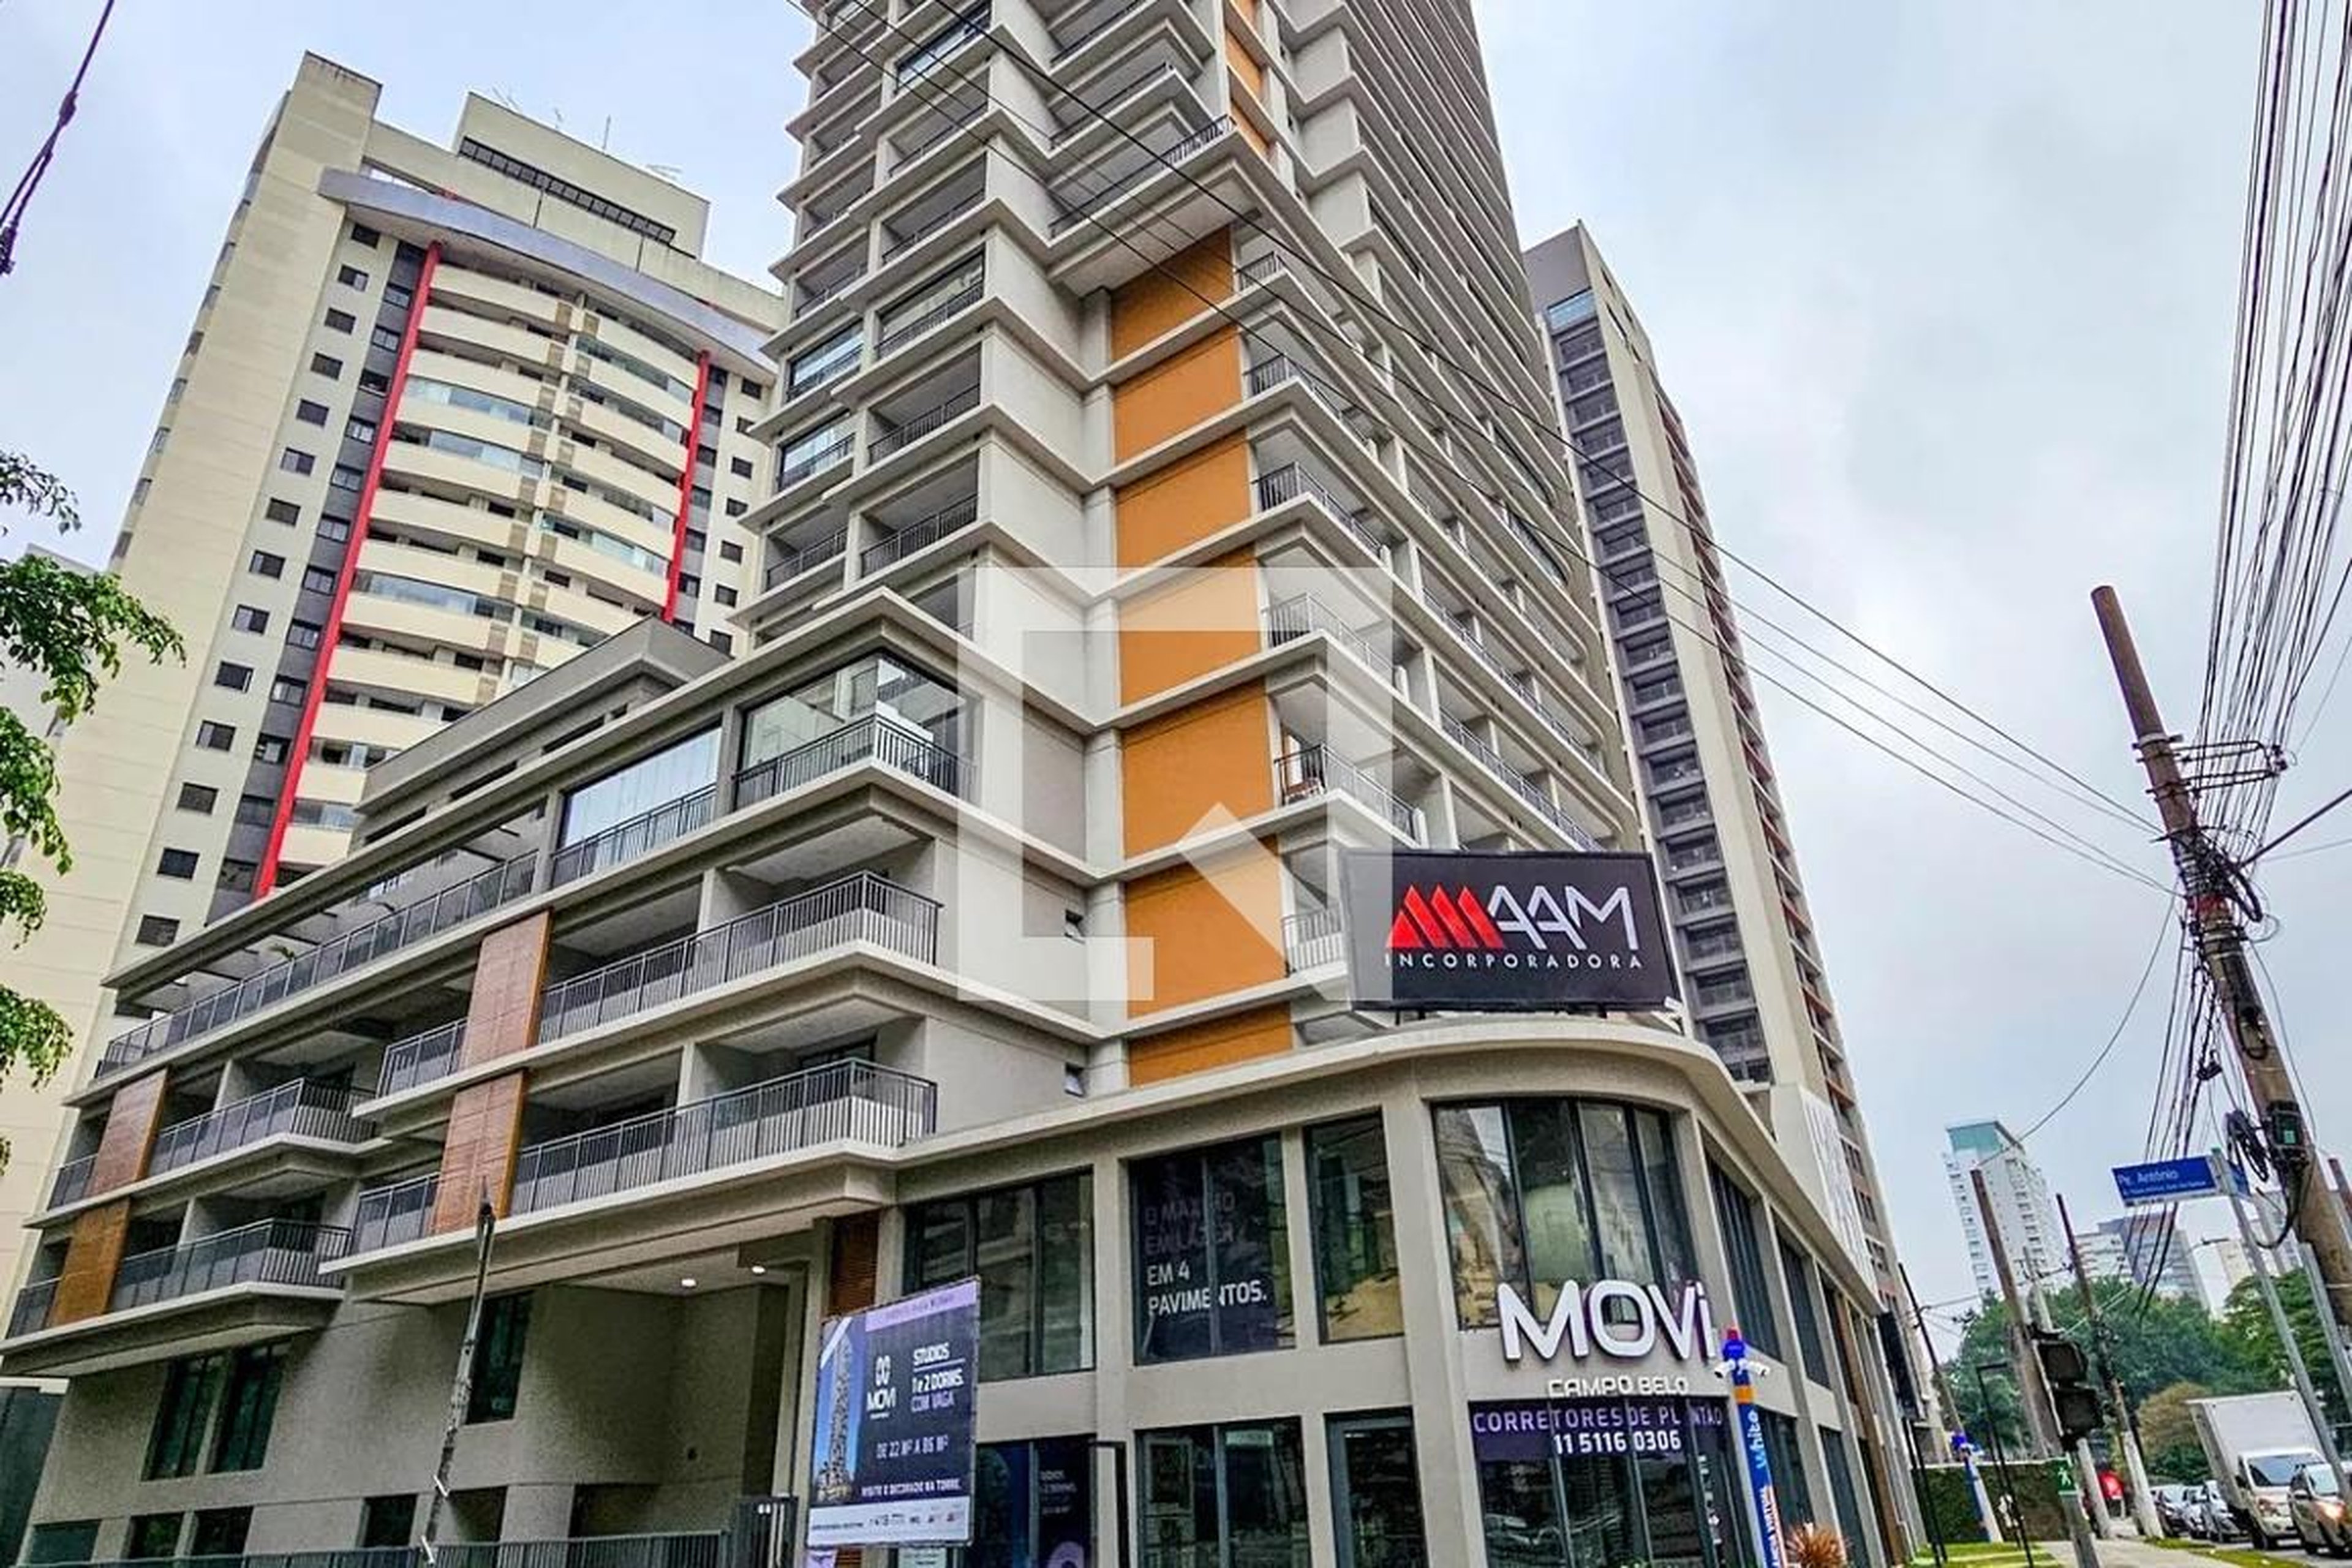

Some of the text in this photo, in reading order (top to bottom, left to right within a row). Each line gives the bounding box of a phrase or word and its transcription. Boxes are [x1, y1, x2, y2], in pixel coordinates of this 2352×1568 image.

[1385, 952, 1643, 969] INCORPORADORA
[1146, 1260, 1191, 1286] EM 4
[1548, 1375, 1689, 1398] CAMPO BELO
[1472, 1409, 1624, 1433] CORRETORES
[1629, 1408, 1651, 1427] DE
[1553, 1429, 1683, 1455] 11 5116 0306
